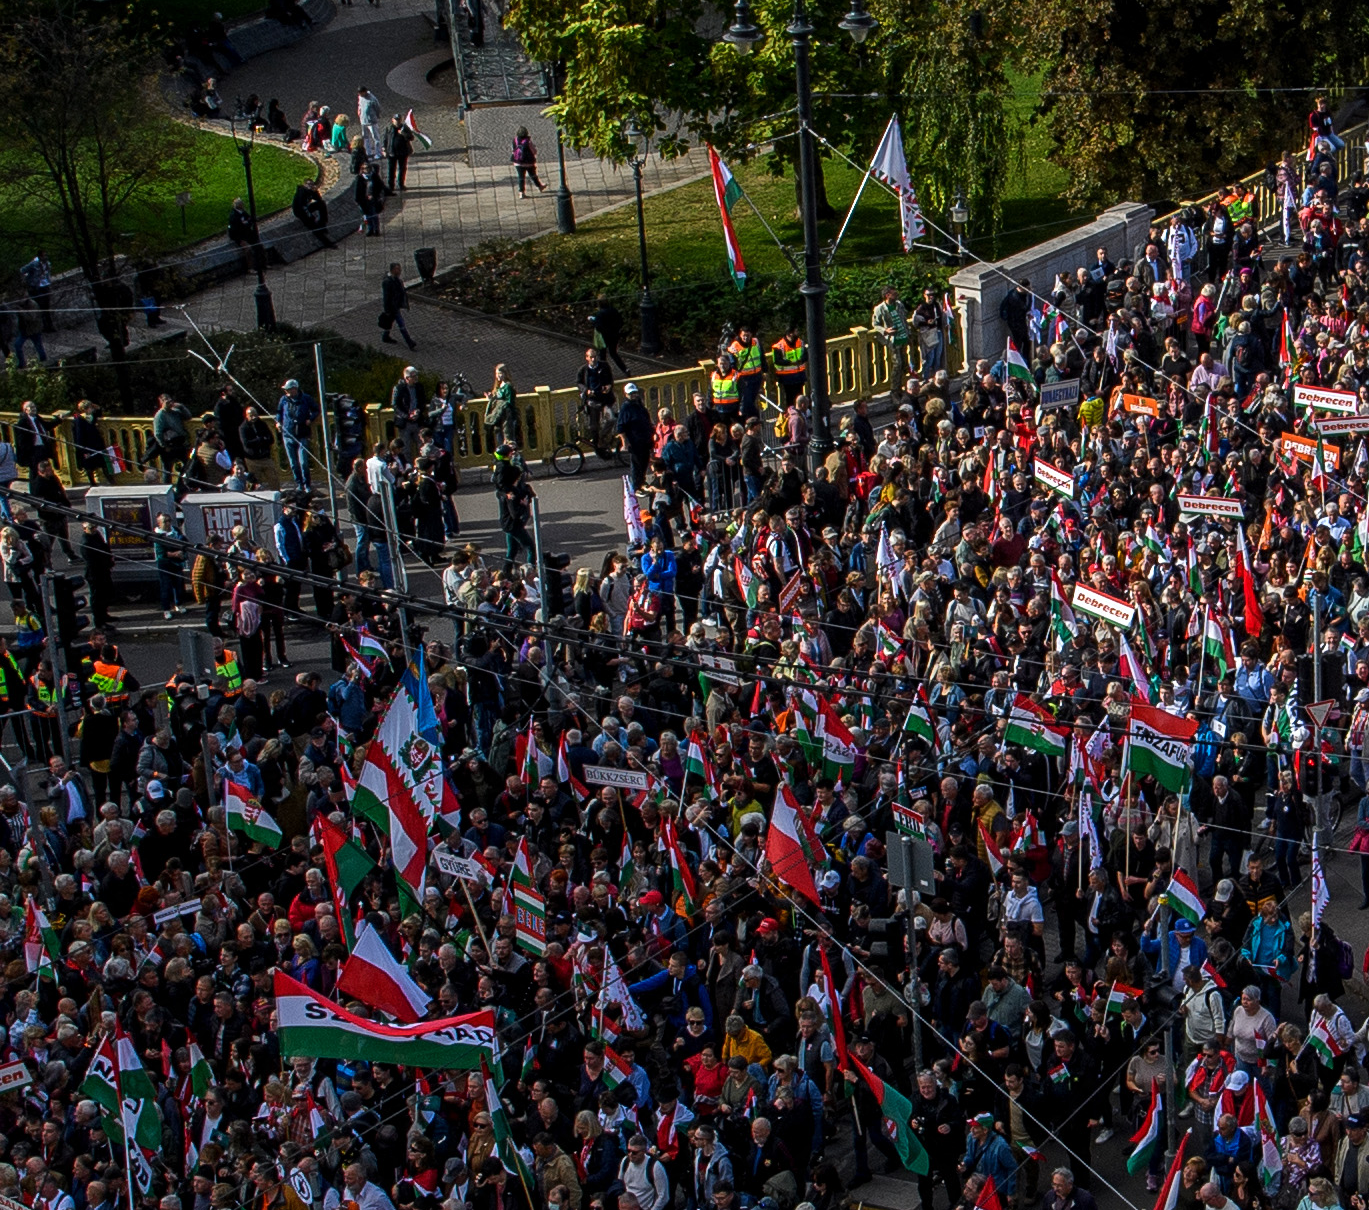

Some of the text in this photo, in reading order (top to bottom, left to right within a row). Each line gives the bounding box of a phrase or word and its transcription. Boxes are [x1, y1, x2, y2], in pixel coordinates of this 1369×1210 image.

[1298, 392, 1353, 407] Debrecen
[1284, 441, 1337, 463] DEBREEN
[1037, 467, 1071, 490] Debrecen
[206, 507, 249, 529] HIFI
[1184, 501, 1239, 513] Debrecen
[1077, 592, 1129, 621] Debrecen
